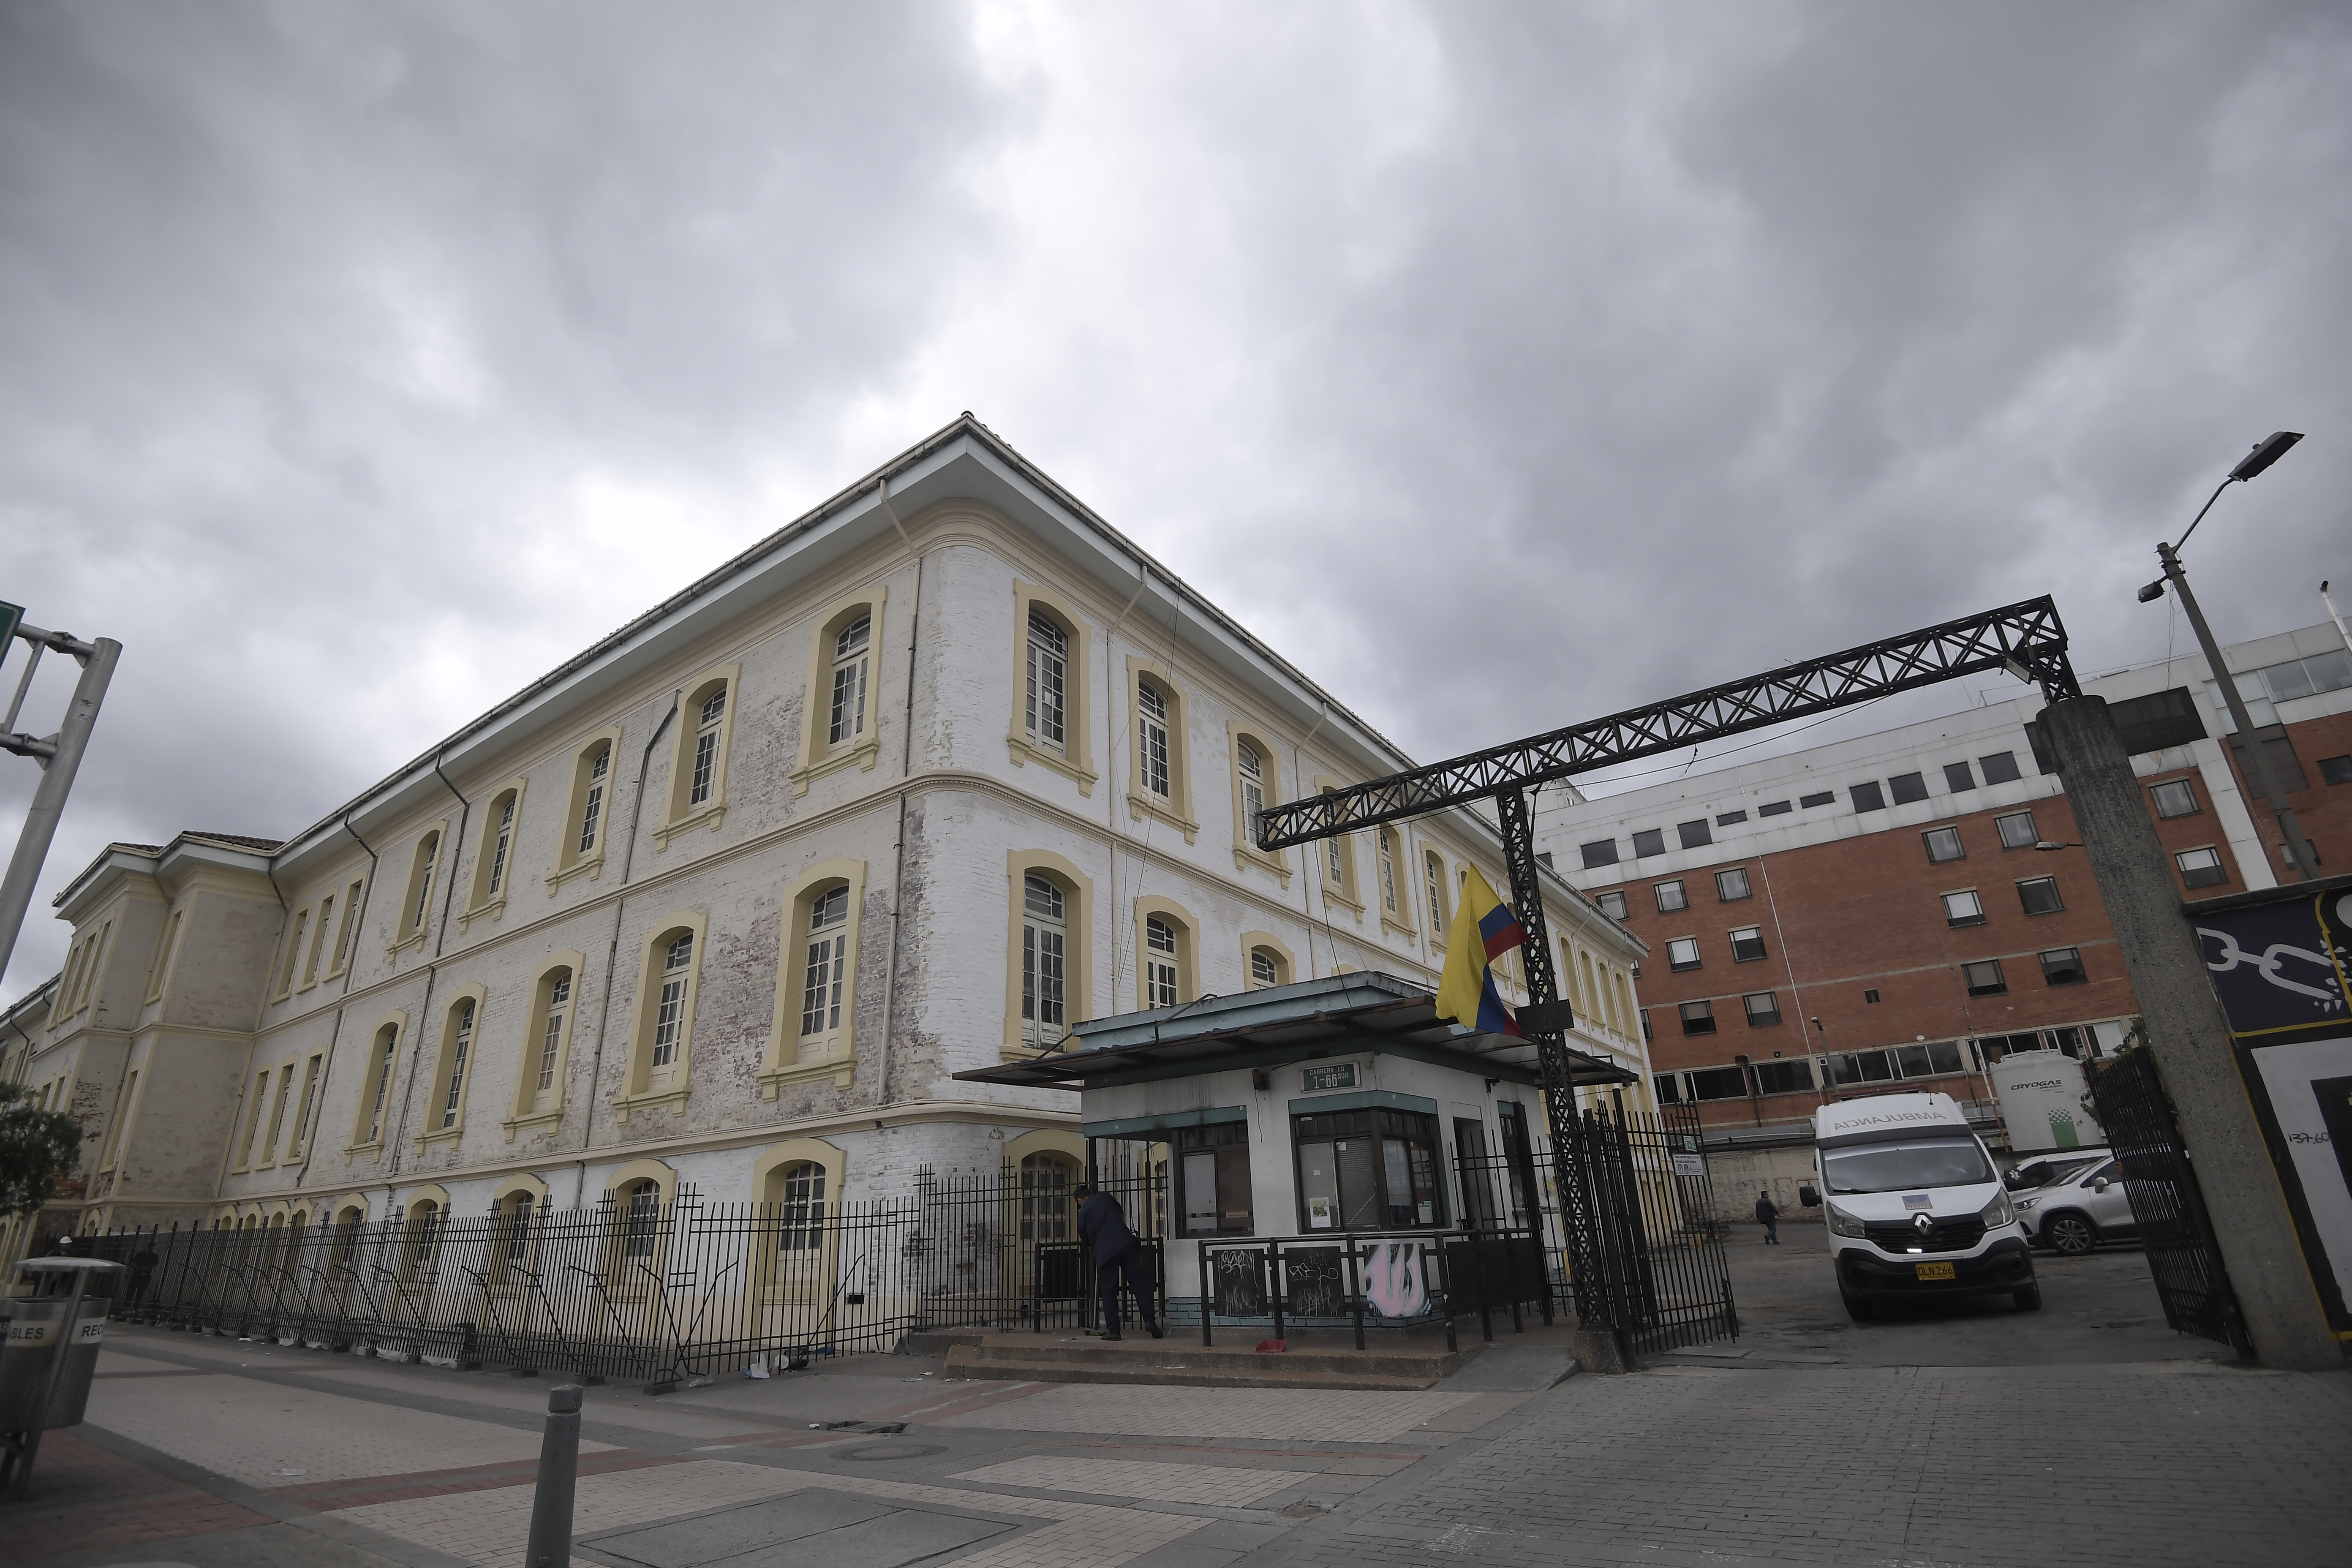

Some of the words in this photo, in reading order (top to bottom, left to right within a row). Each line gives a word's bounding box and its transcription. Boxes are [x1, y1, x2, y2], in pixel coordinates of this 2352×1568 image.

[1310, 1067, 1334, 1075] CARRERA
[1314, 1074, 1338, 1089] 1-66
[2011, 1079, 2061, 1090] CRYOGAS
[1936, 1265, 1953, 1275] 266
